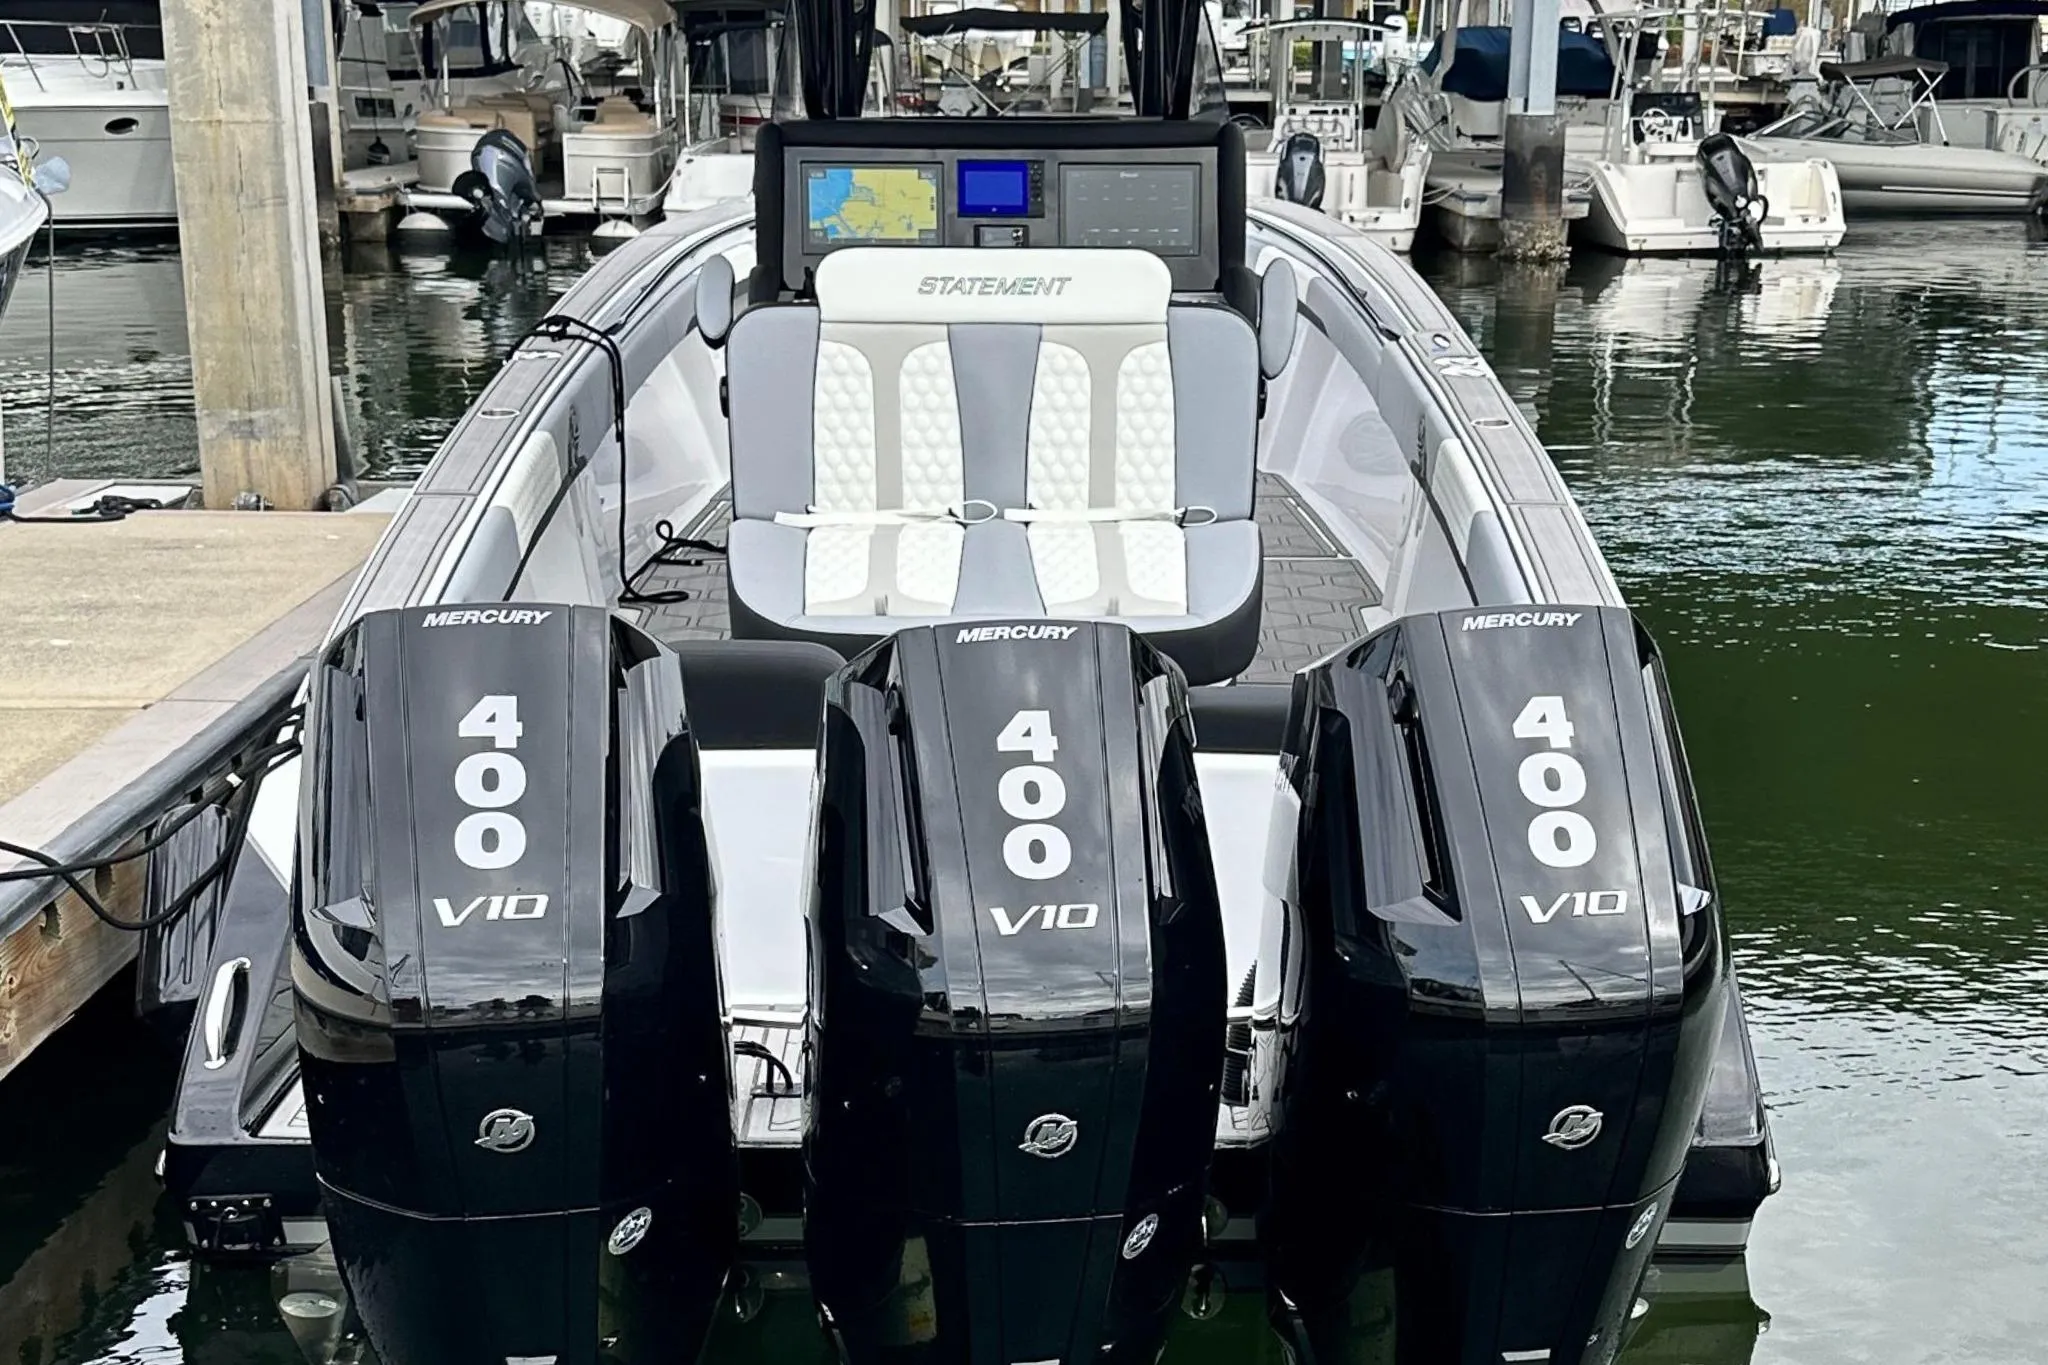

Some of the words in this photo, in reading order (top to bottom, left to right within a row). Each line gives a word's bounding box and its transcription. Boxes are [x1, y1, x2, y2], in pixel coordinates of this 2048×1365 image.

[918, 275, 1073, 296] STATEMENT
[422, 609, 552, 628] MERCURY
[956, 625, 1078, 644] MERCURY
[1461, 611, 1582, 632] MERCURY
[454, 695, 527, 870] 400
[996, 710, 1072, 880] 400
[1512, 695, 1597, 868] 400
[433, 894, 549, 927] V10
[989, 903, 1099, 936] V10
[1519, 889, 1627, 924] V10
